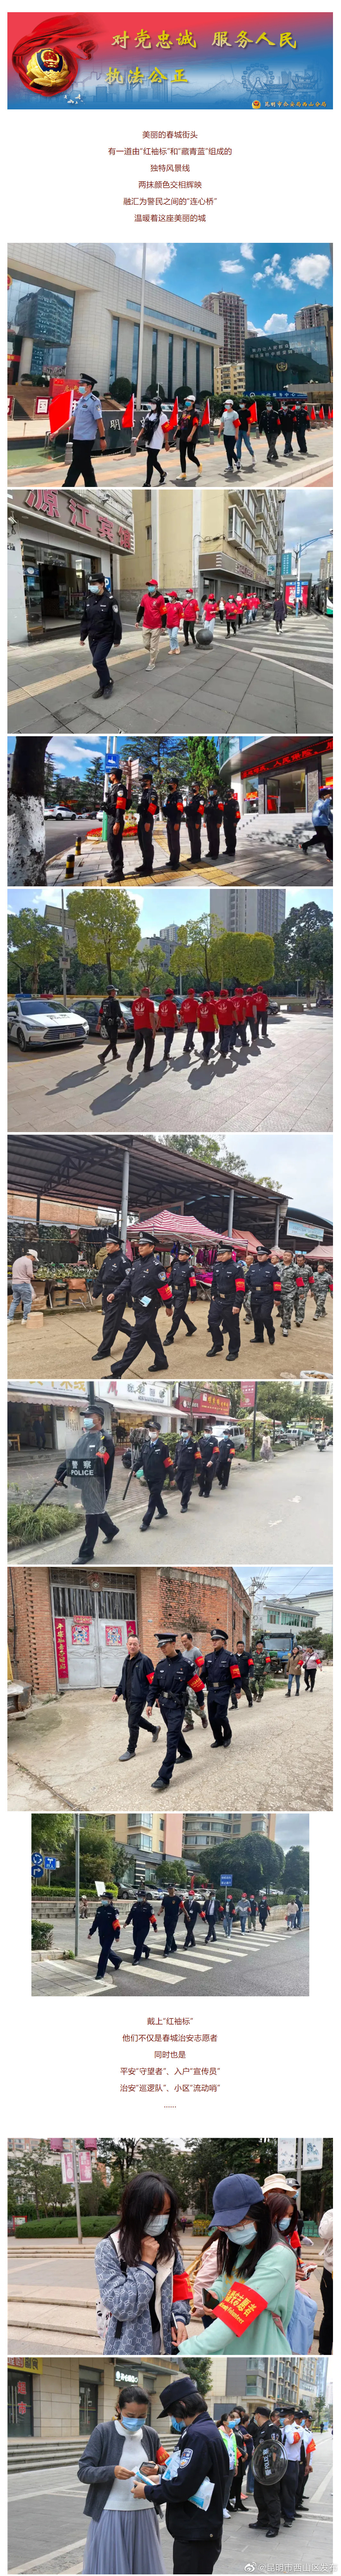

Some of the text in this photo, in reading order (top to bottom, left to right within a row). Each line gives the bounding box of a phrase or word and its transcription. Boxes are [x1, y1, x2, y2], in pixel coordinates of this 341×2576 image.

[71, 1460, 92, 1470] 警察
[227, 2307, 245, 2324] Volunteer
[17, 2381, 27, 2415] 超市
